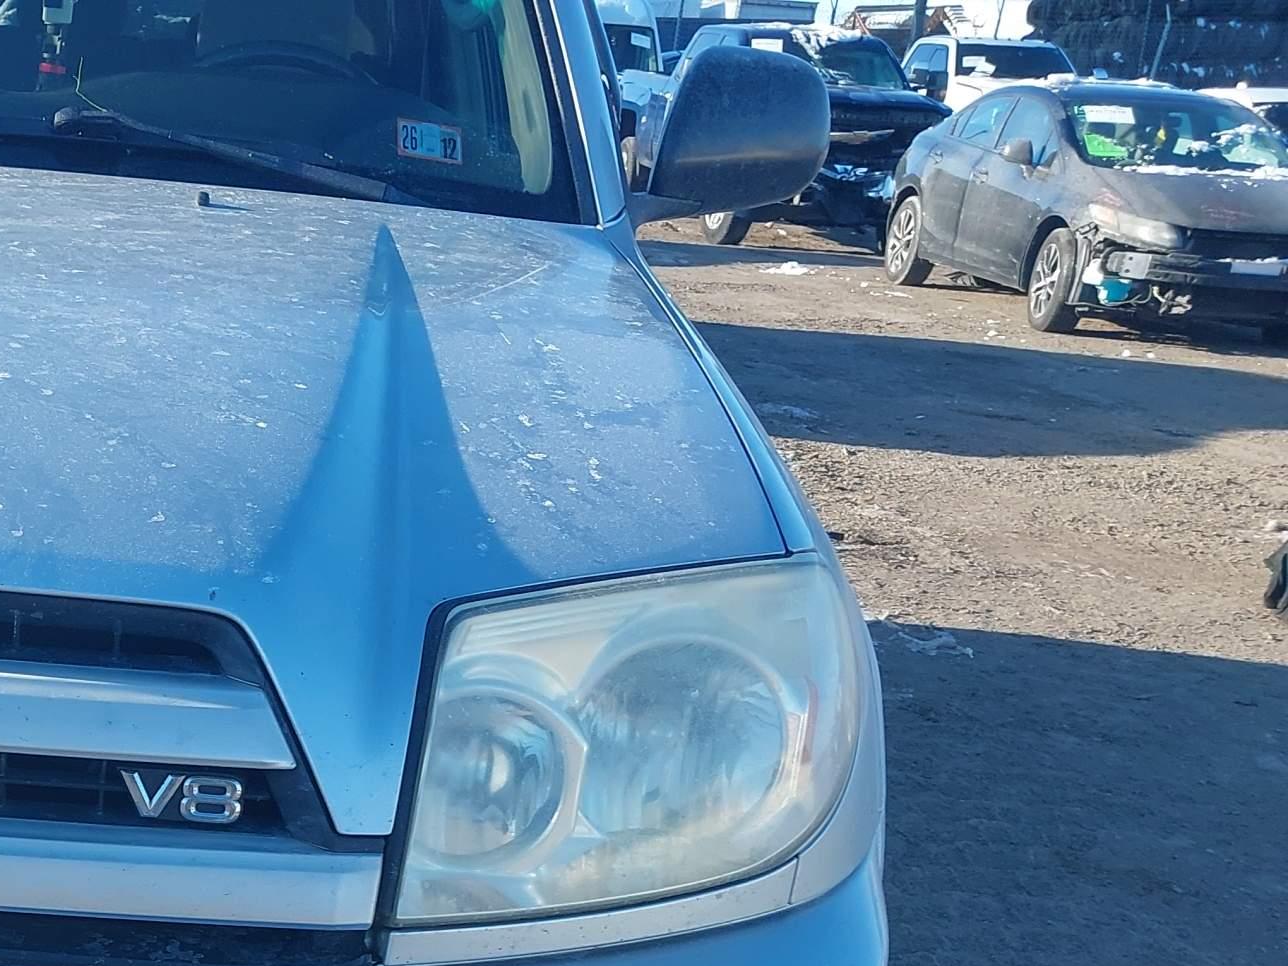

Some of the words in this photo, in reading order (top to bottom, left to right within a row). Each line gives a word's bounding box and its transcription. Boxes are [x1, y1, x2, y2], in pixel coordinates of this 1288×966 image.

[402, 124, 418, 151] 26
[440, 137, 458, 161] 12
[119, 769, 243, 824] V8
